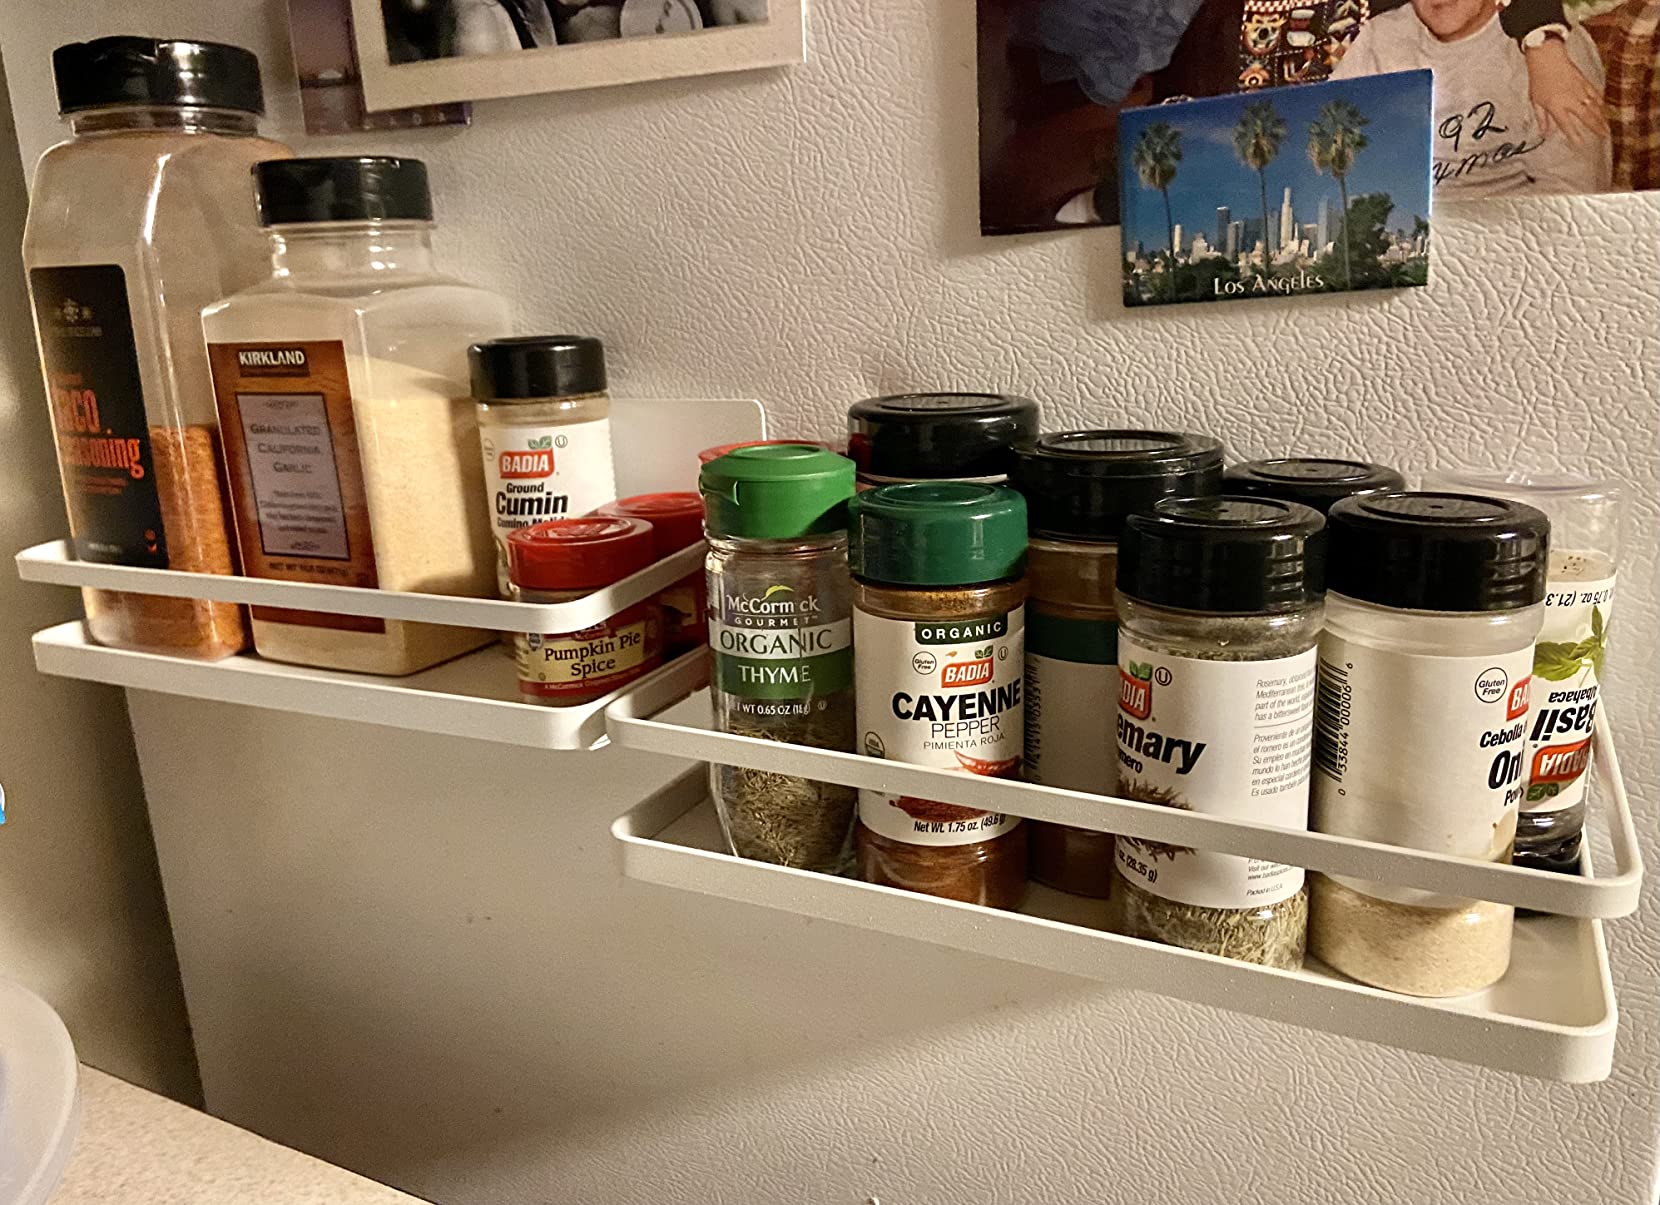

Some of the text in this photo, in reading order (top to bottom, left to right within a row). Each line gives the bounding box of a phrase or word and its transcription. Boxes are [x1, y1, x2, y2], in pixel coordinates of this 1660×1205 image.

[1438, 101, 1509, 152] 92
[239, 350, 305, 365] KIRKLAND
[250, 423, 321, 436] GRANULATED
[257, 443, 321, 455] CALIFORNIA
[273, 462, 313, 474] GARLIC
[502, 454, 549, 473] BADIA
[506, 482, 545, 494] Ground
[496, 491, 568, 516] Cumin
[726, 593, 821, 615] McCormck
[1545, 590, 1577, 607] (21.3
[1580, 592, 1593, 604] oz.
[734, 616, 809, 628] GOURMET
[921, 621, 1002, 640] ORGANIC
[544, 630, 641, 662] Pumpkin Pie
[720, 628, 833, 655] ORGANIC
[571, 656, 616, 679] Spice
[914, 657, 935, 666] Gluten
[738, 664, 812, 685] THYME
[945, 662, 990, 683] BADIA
[1478, 679, 1505, 689] Gluten
[1482, 687, 1501, 696] Free
[892, 677, 1022, 722] CAYENNE
[1340, 685, 1352, 726] 00006
[742, 703, 756, 714] WT
[757, 704, 776, 715] 0.65
[777, 704, 792, 715] OZ
[931, 714, 1001, 739] PEPPER
[923, 733, 1006, 750] PIMIENTA ROJA
[1479, 724, 1523, 748] Cebolla
[1338, 732, 1349, 772] 33844
[1338, 788, 1346, 796] 0
[914, 821, 930, 832] Net
[947, 821, 966, 833] 1.75
[967, 821, 979, 831] oz.
